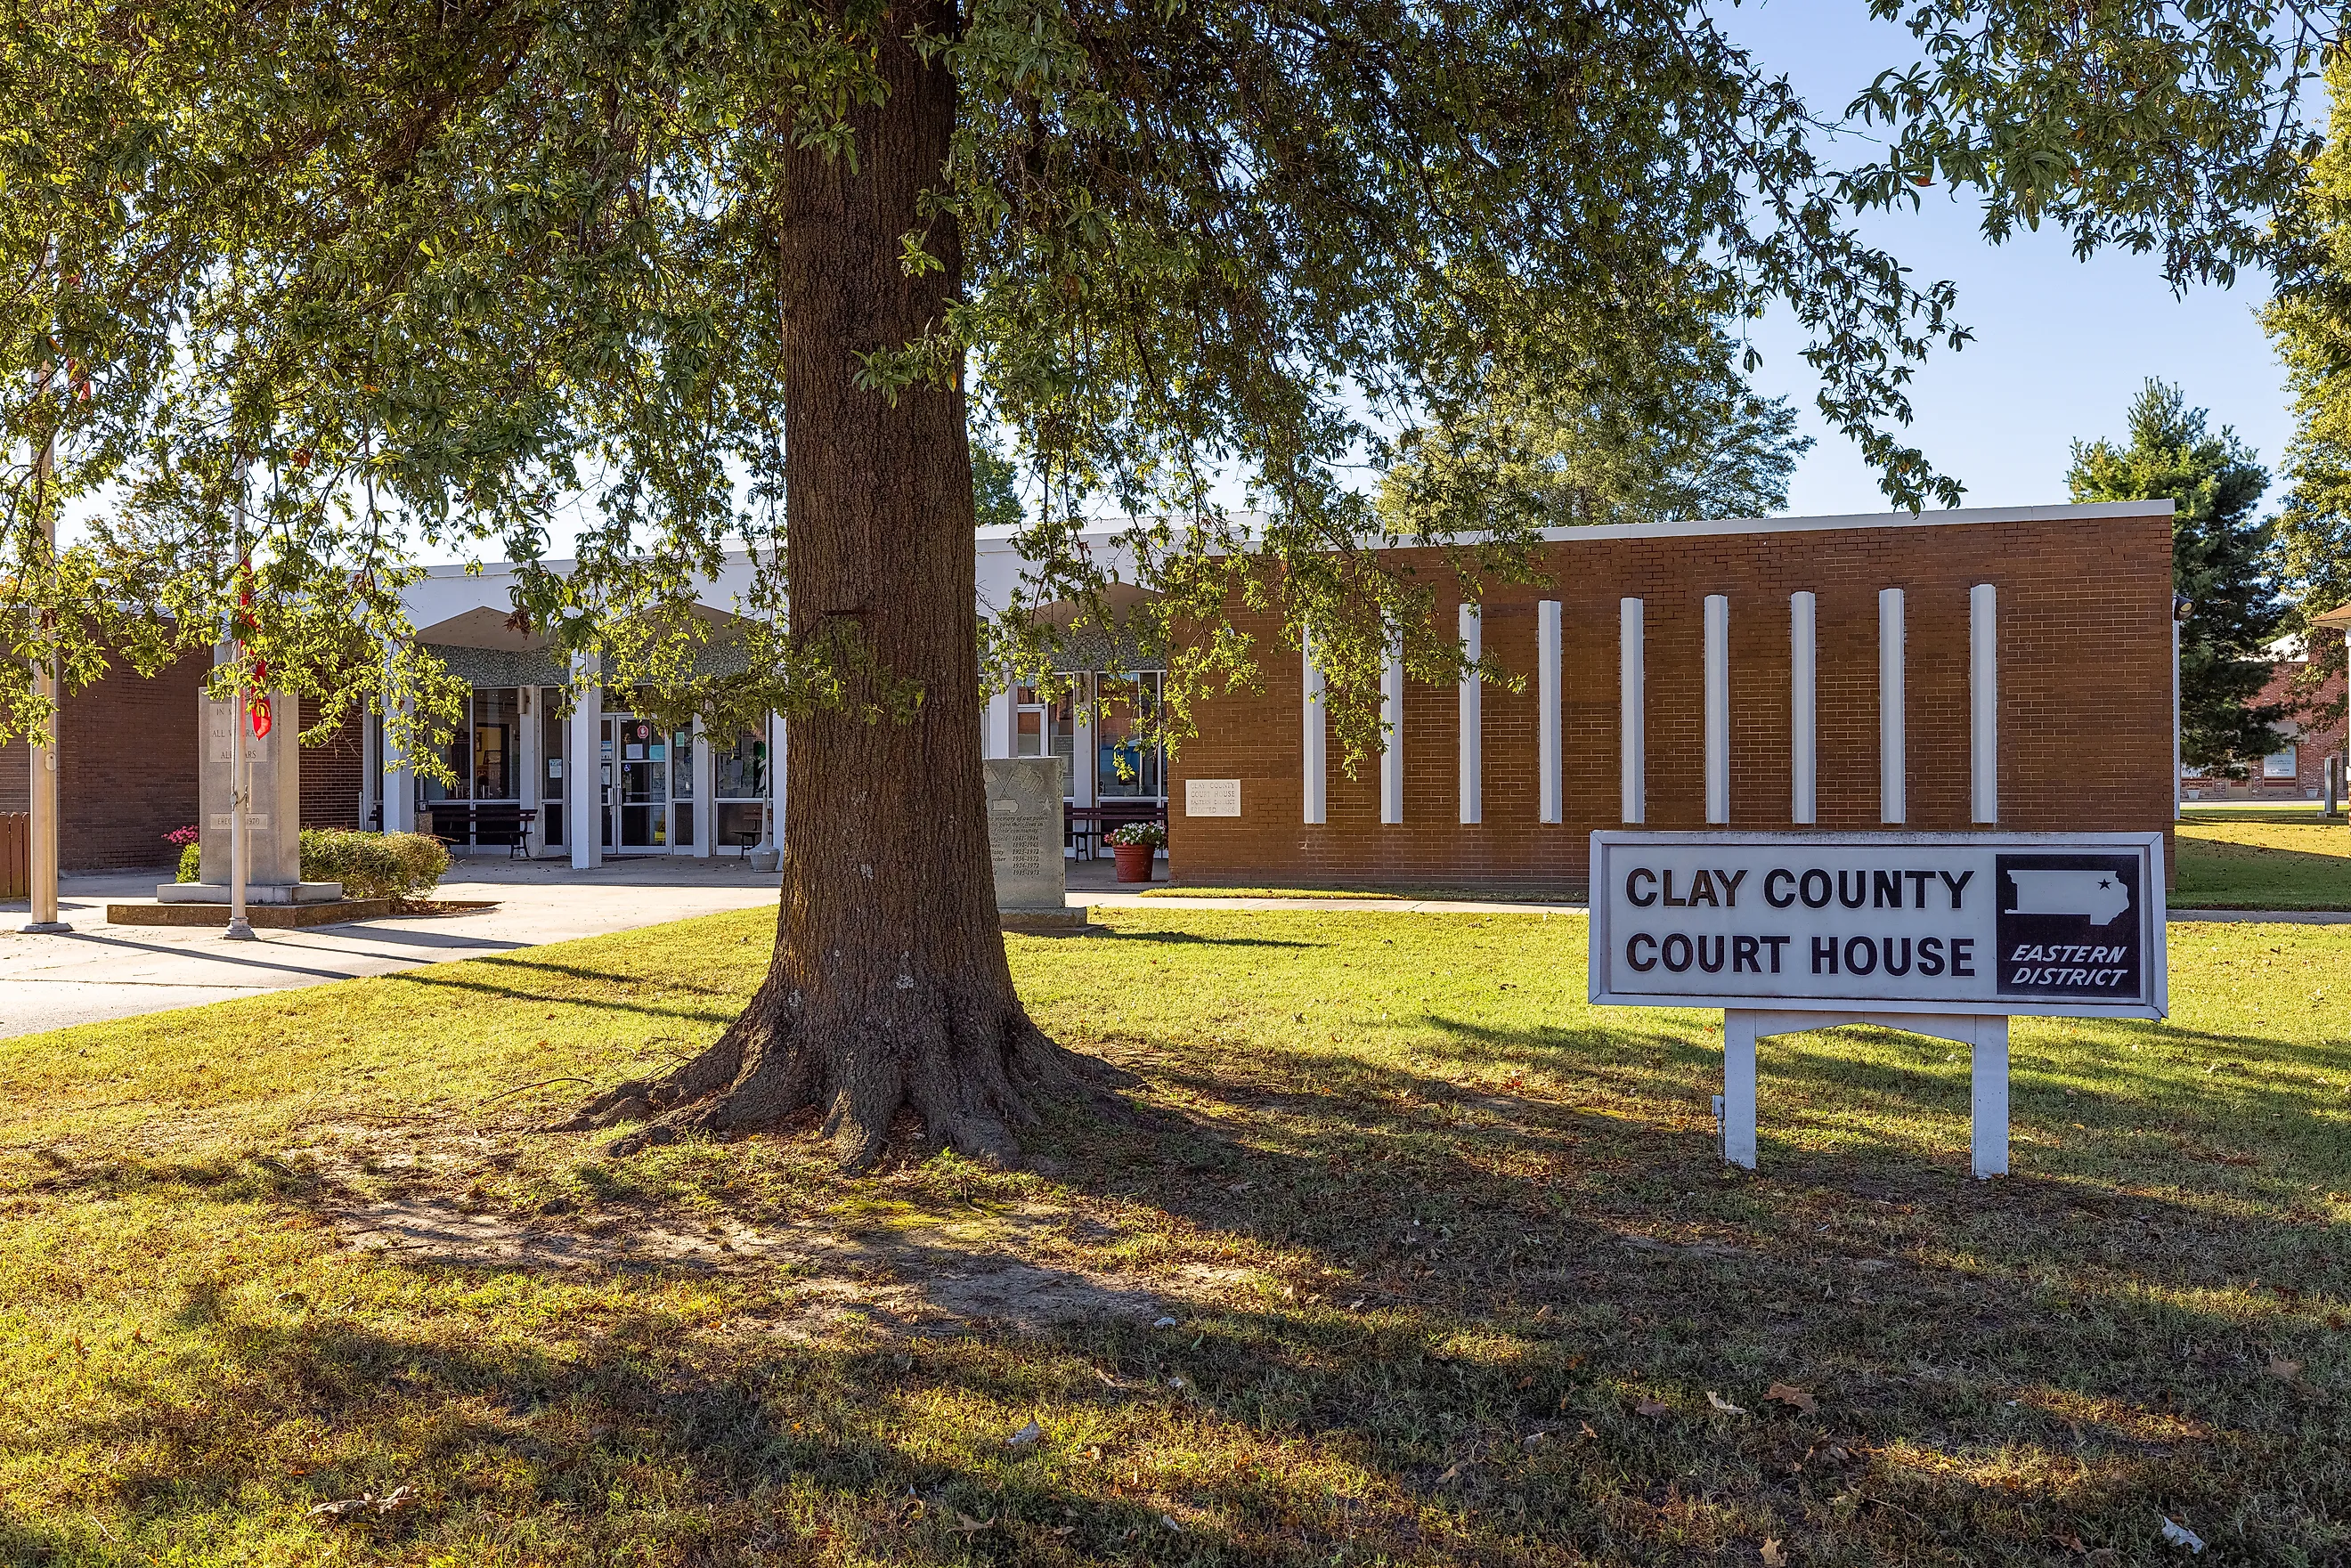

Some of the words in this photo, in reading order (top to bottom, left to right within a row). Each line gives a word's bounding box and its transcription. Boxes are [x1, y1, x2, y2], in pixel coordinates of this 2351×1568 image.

[212, 728, 225, 738] ALL
[1625, 867, 1749, 908] CLAY
[1762, 867, 1976, 910] COUNTY
[1625, 931, 1791, 974] COURT
[1810, 935, 1976, 977] HOUSE
[2010, 944, 2128, 963] EASTERN
[2010, 967, 2129, 987] DISTRICT
